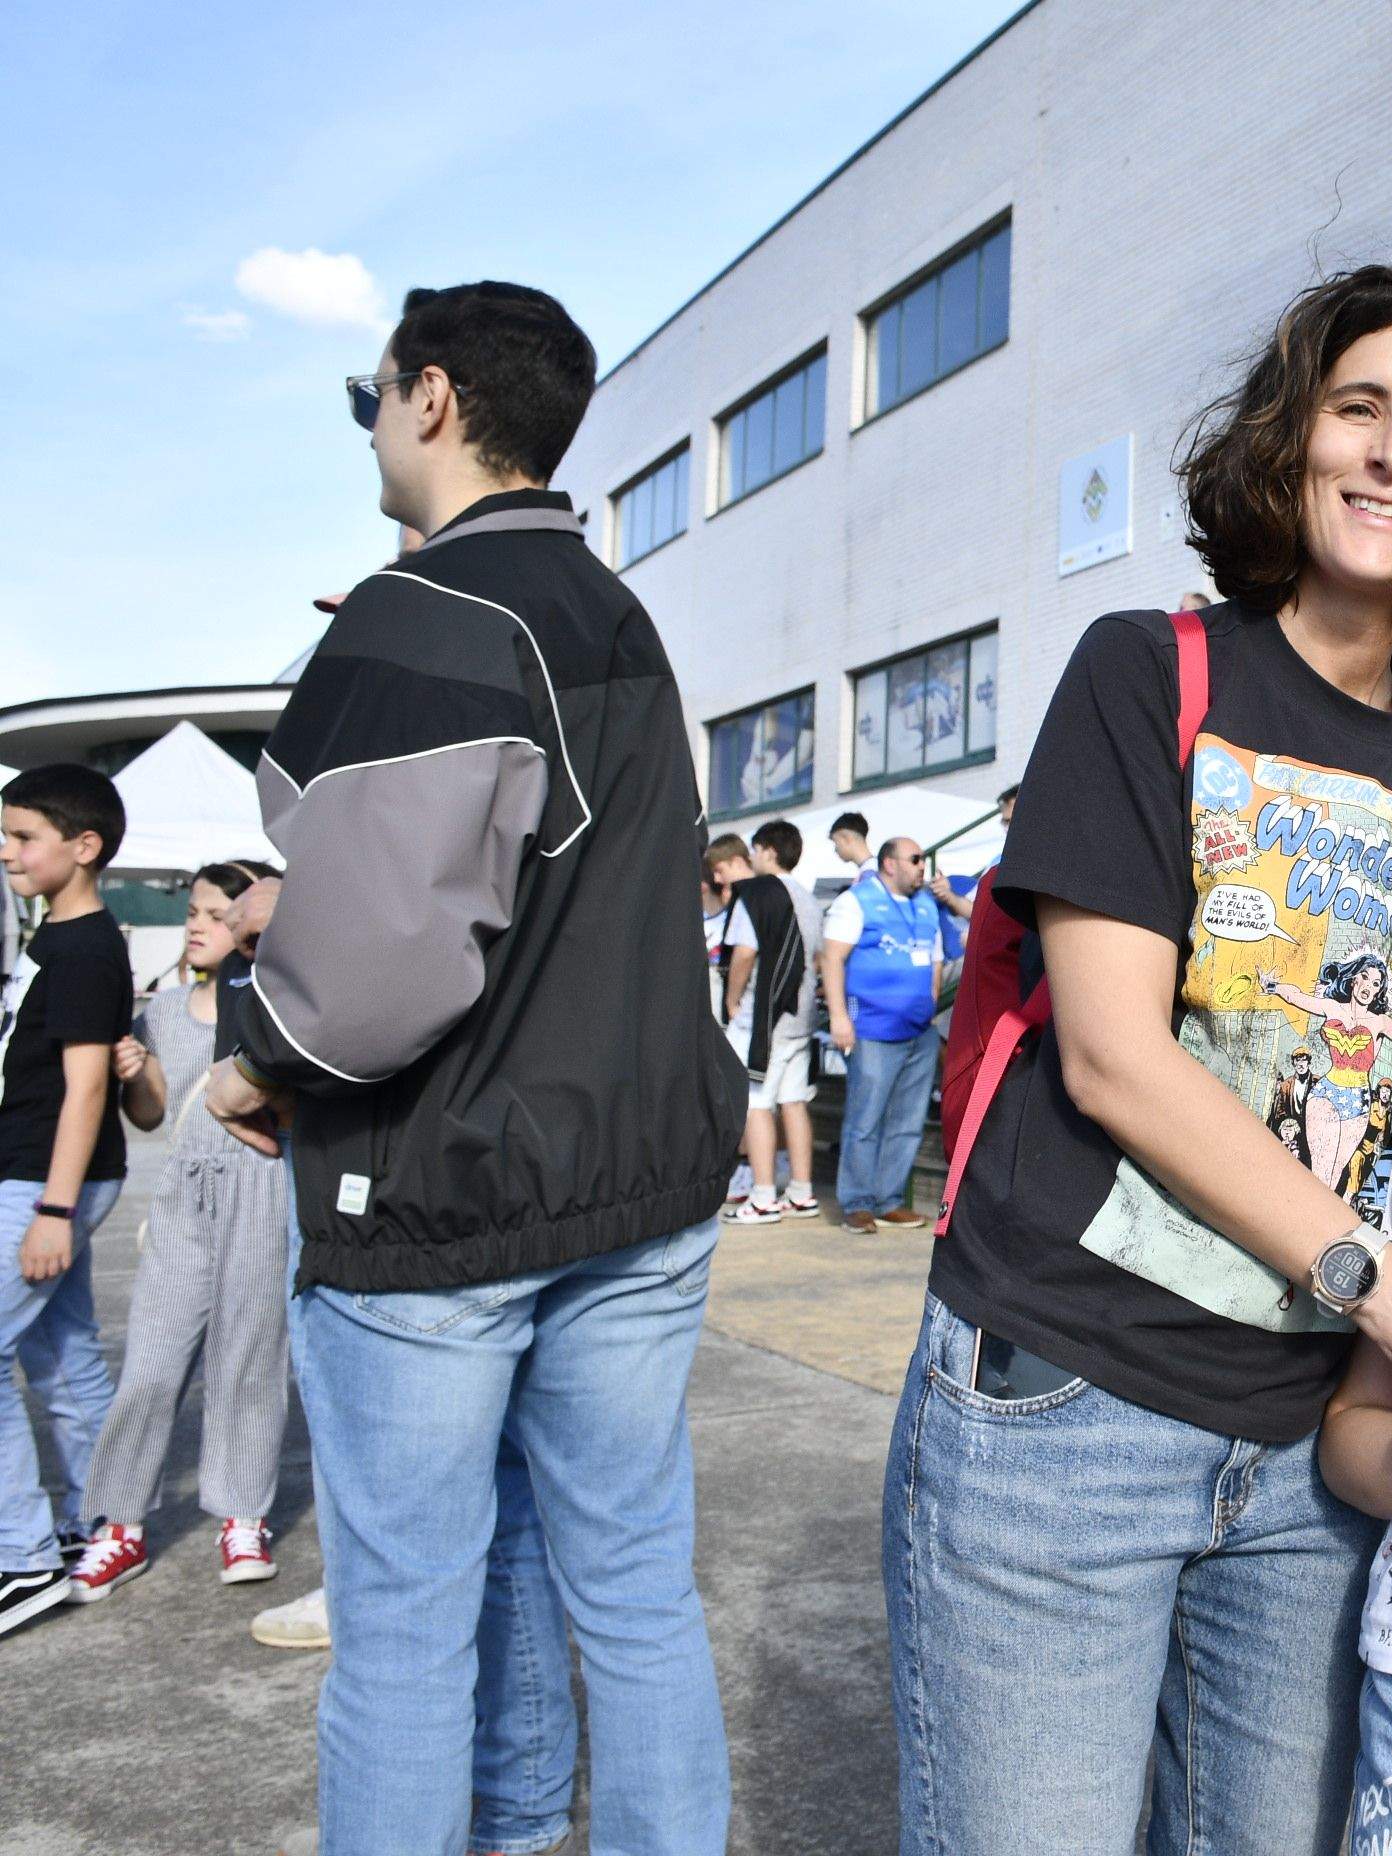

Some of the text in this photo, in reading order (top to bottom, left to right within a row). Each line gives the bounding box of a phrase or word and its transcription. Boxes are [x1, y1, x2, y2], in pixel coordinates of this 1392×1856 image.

[1206, 843, 1248, 866] NEW
[1216, 890, 1261, 902] I'VE HAD
[1212, 899, 1224, 907] MY
[1226, 900, 1247, 910] FILL
[1208, 907, 1223, 915] THE
[1227, 909, 1252, 919] EVILS
[1205, 916, 1270, 932] MAN'S WORLD!
